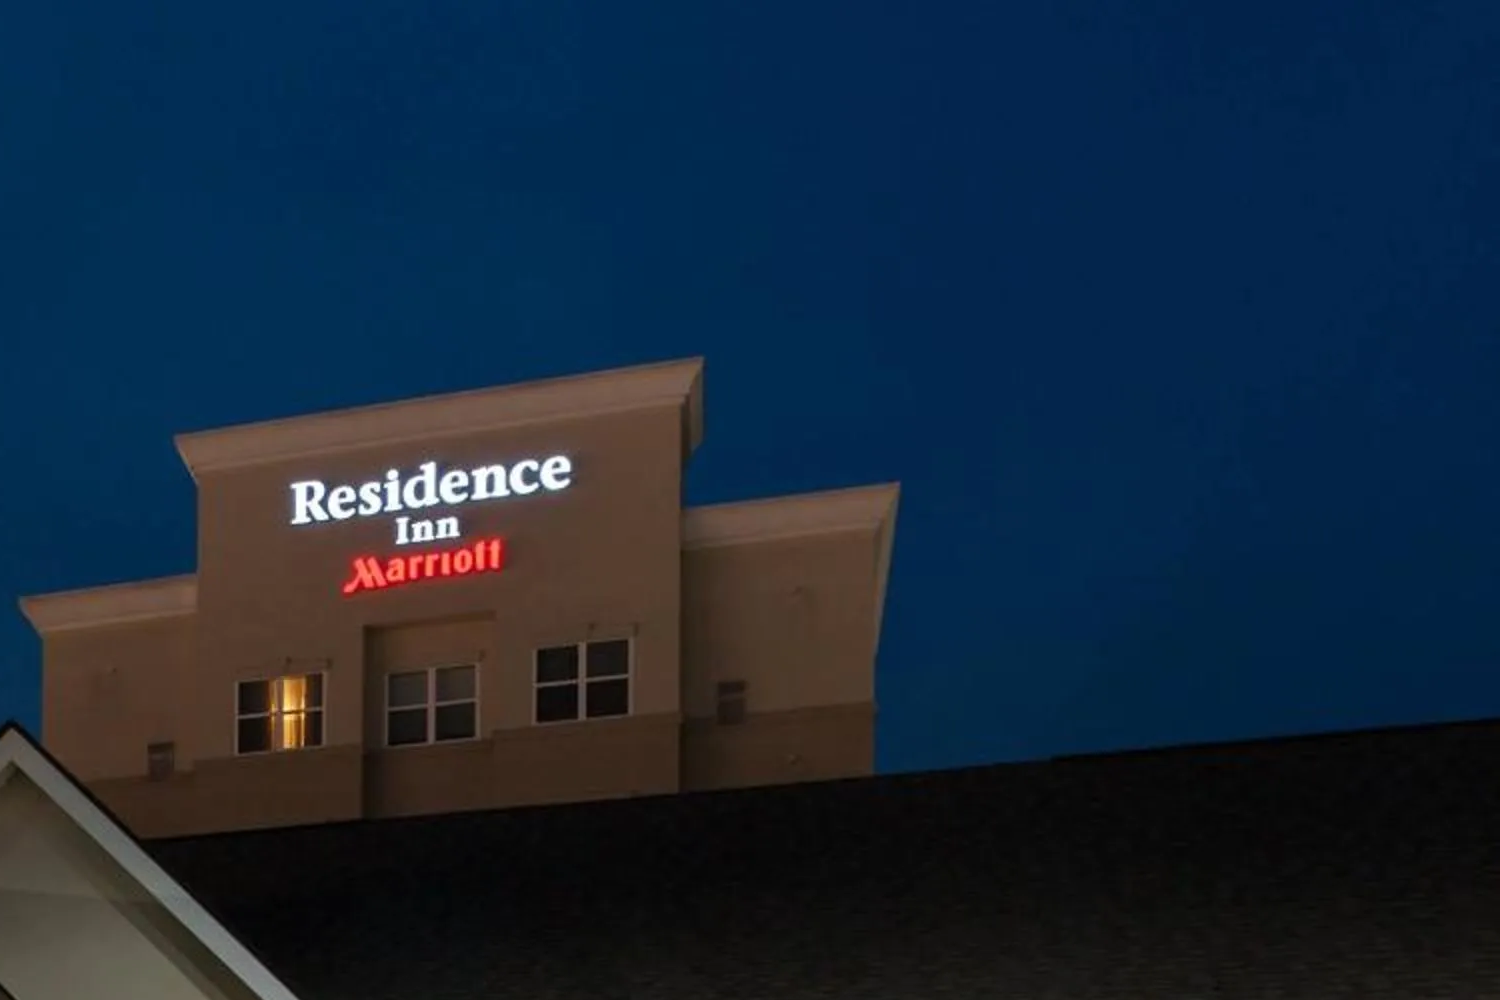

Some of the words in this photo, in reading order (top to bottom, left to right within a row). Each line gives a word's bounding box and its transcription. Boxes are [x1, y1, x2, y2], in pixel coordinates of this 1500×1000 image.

[290, 455, 572, 525] Residence
[395, 515, 461, 545] Inn
[342, 539, 503, 594] Marriott
